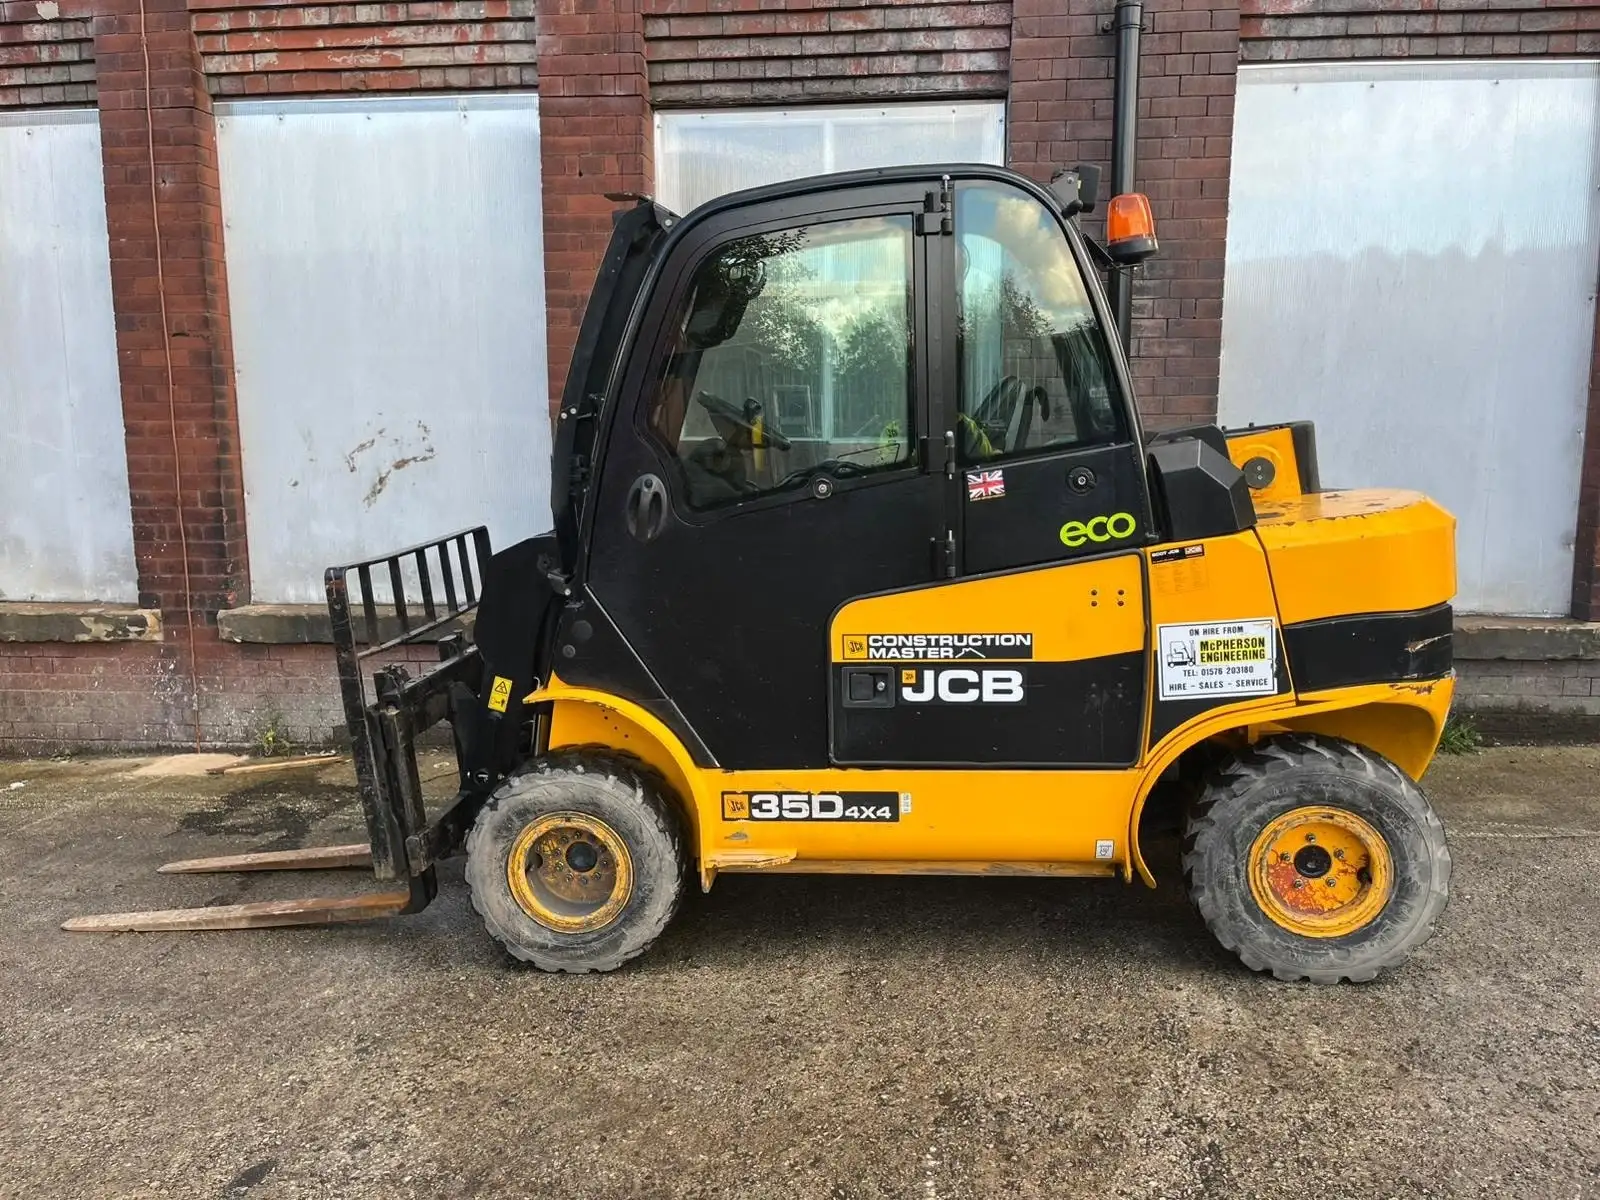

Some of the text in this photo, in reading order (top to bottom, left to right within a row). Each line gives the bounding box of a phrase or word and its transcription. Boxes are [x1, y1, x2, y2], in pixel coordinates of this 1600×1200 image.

[1059, 512, 1136, 547] eco
[1189, 626, 1244, 637] ON HIRE FROM
[868, 634, 1031, 647] CONSTRUCTION
[1200, 637, 1265, 651] McPHERSON
[869, 647, 954, 659] MASTER
[1200, 649, 1265, 663] ENGINEERING
[1183, 669, 1198, 677] TEL:
[1226, 666, 1254, 675] 203180
[902, 669, 1024, 702] JCB
[1169, 683, 1187, 691] HIRE
[1200, 681, 1224, 689] SALES
[1235, 678, 1268, 687] SERVICE
[751, 794, 844, 819] 35D
